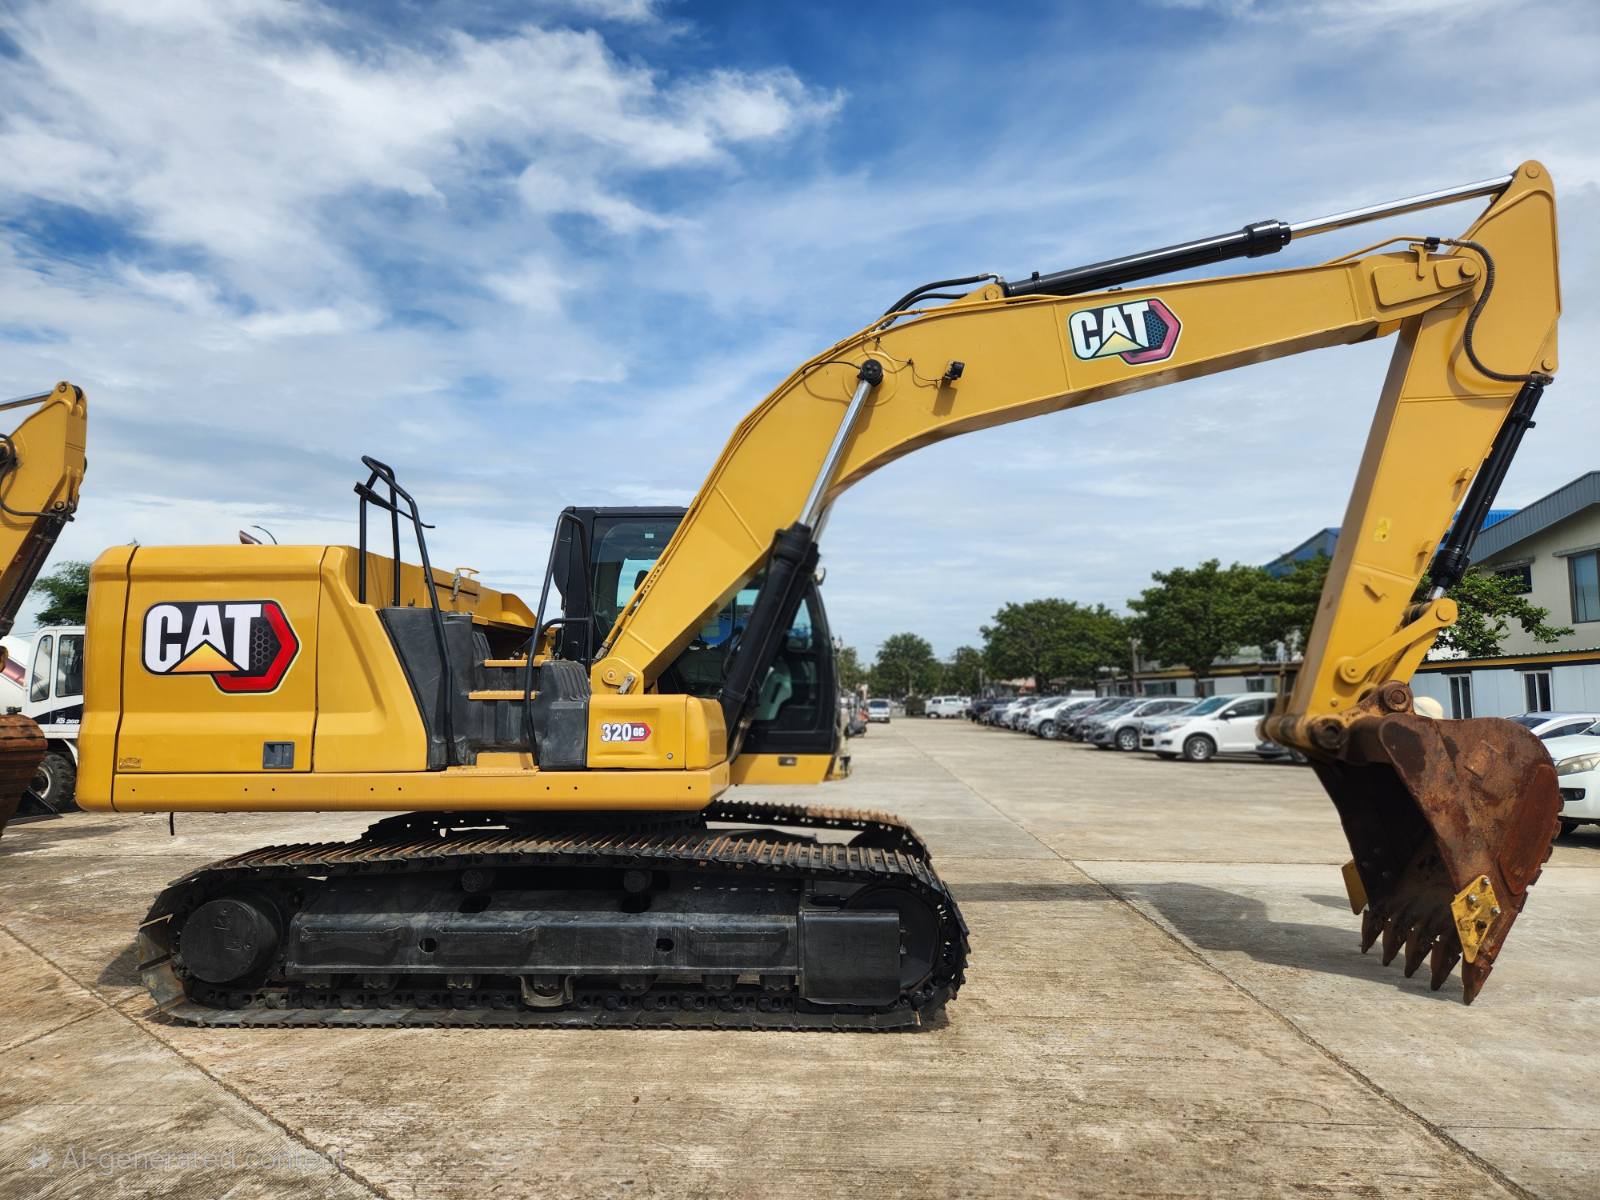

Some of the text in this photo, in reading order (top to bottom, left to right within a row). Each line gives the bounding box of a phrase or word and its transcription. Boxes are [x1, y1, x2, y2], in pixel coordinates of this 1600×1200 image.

[1070, 301, 1150, 358] CAT
[145, 604, 262, 673] CAT
[601, 723, 632, 741] 320
